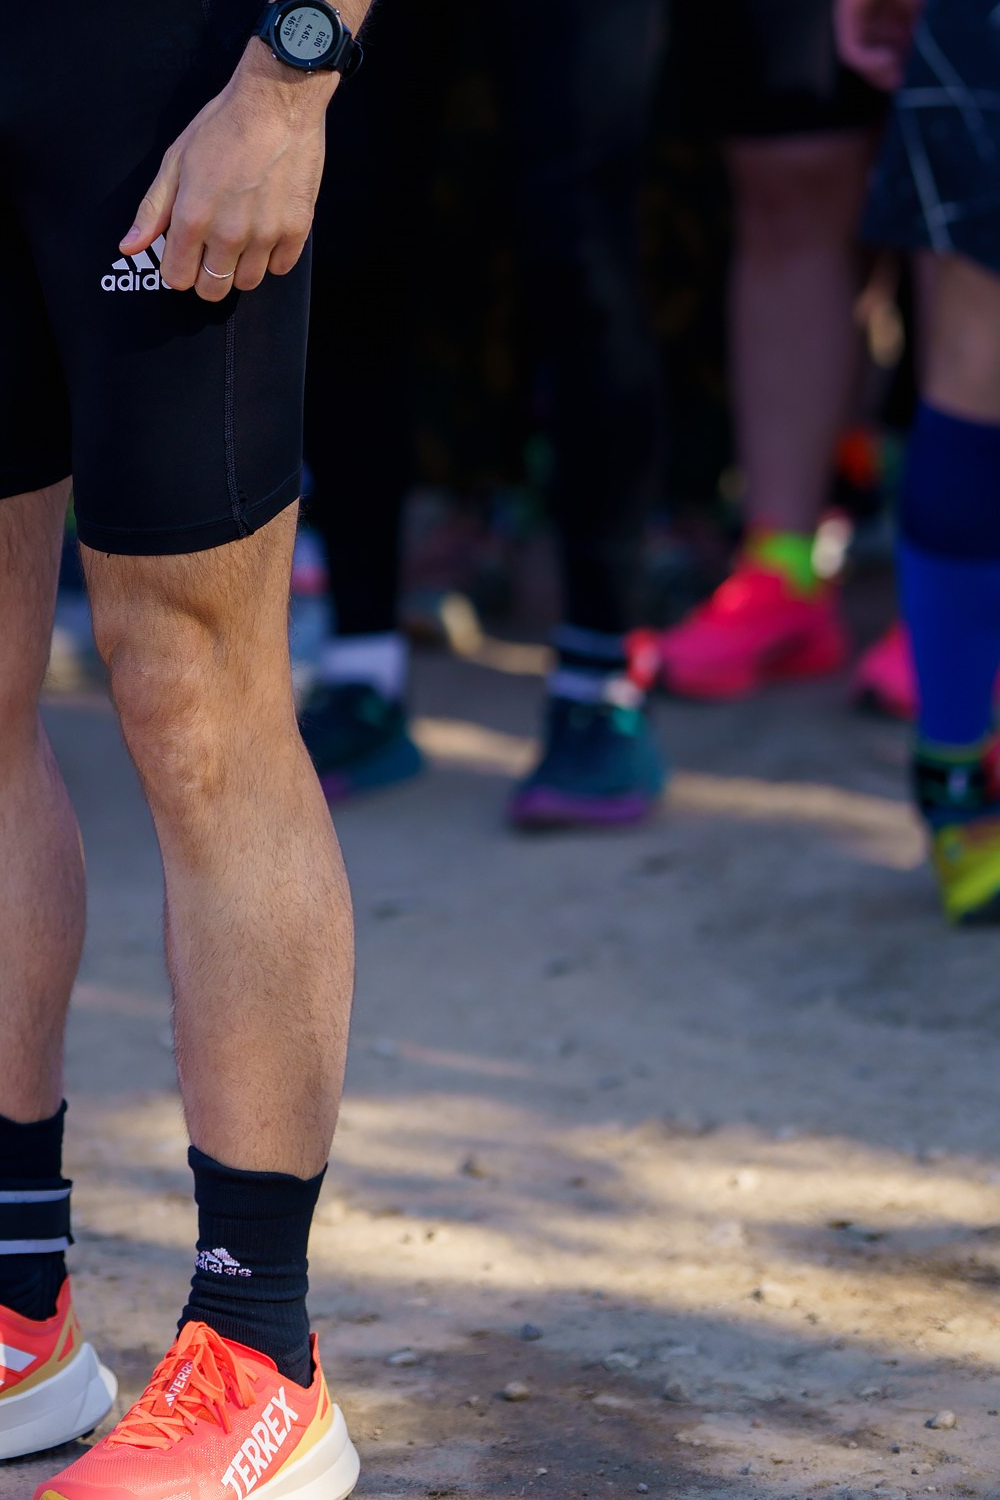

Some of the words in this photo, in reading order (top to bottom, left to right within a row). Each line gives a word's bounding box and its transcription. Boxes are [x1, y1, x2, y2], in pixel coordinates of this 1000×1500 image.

[283, 15, 297, 36] 46:19
[301, 23, 313, 41] 4:45
[313, 30, 326, 48] 0:00
[100, 269, 173, 292] adid
[168, 1360, 194, 1394] TERR
[220, 1385, 300, 1500] TERREX
